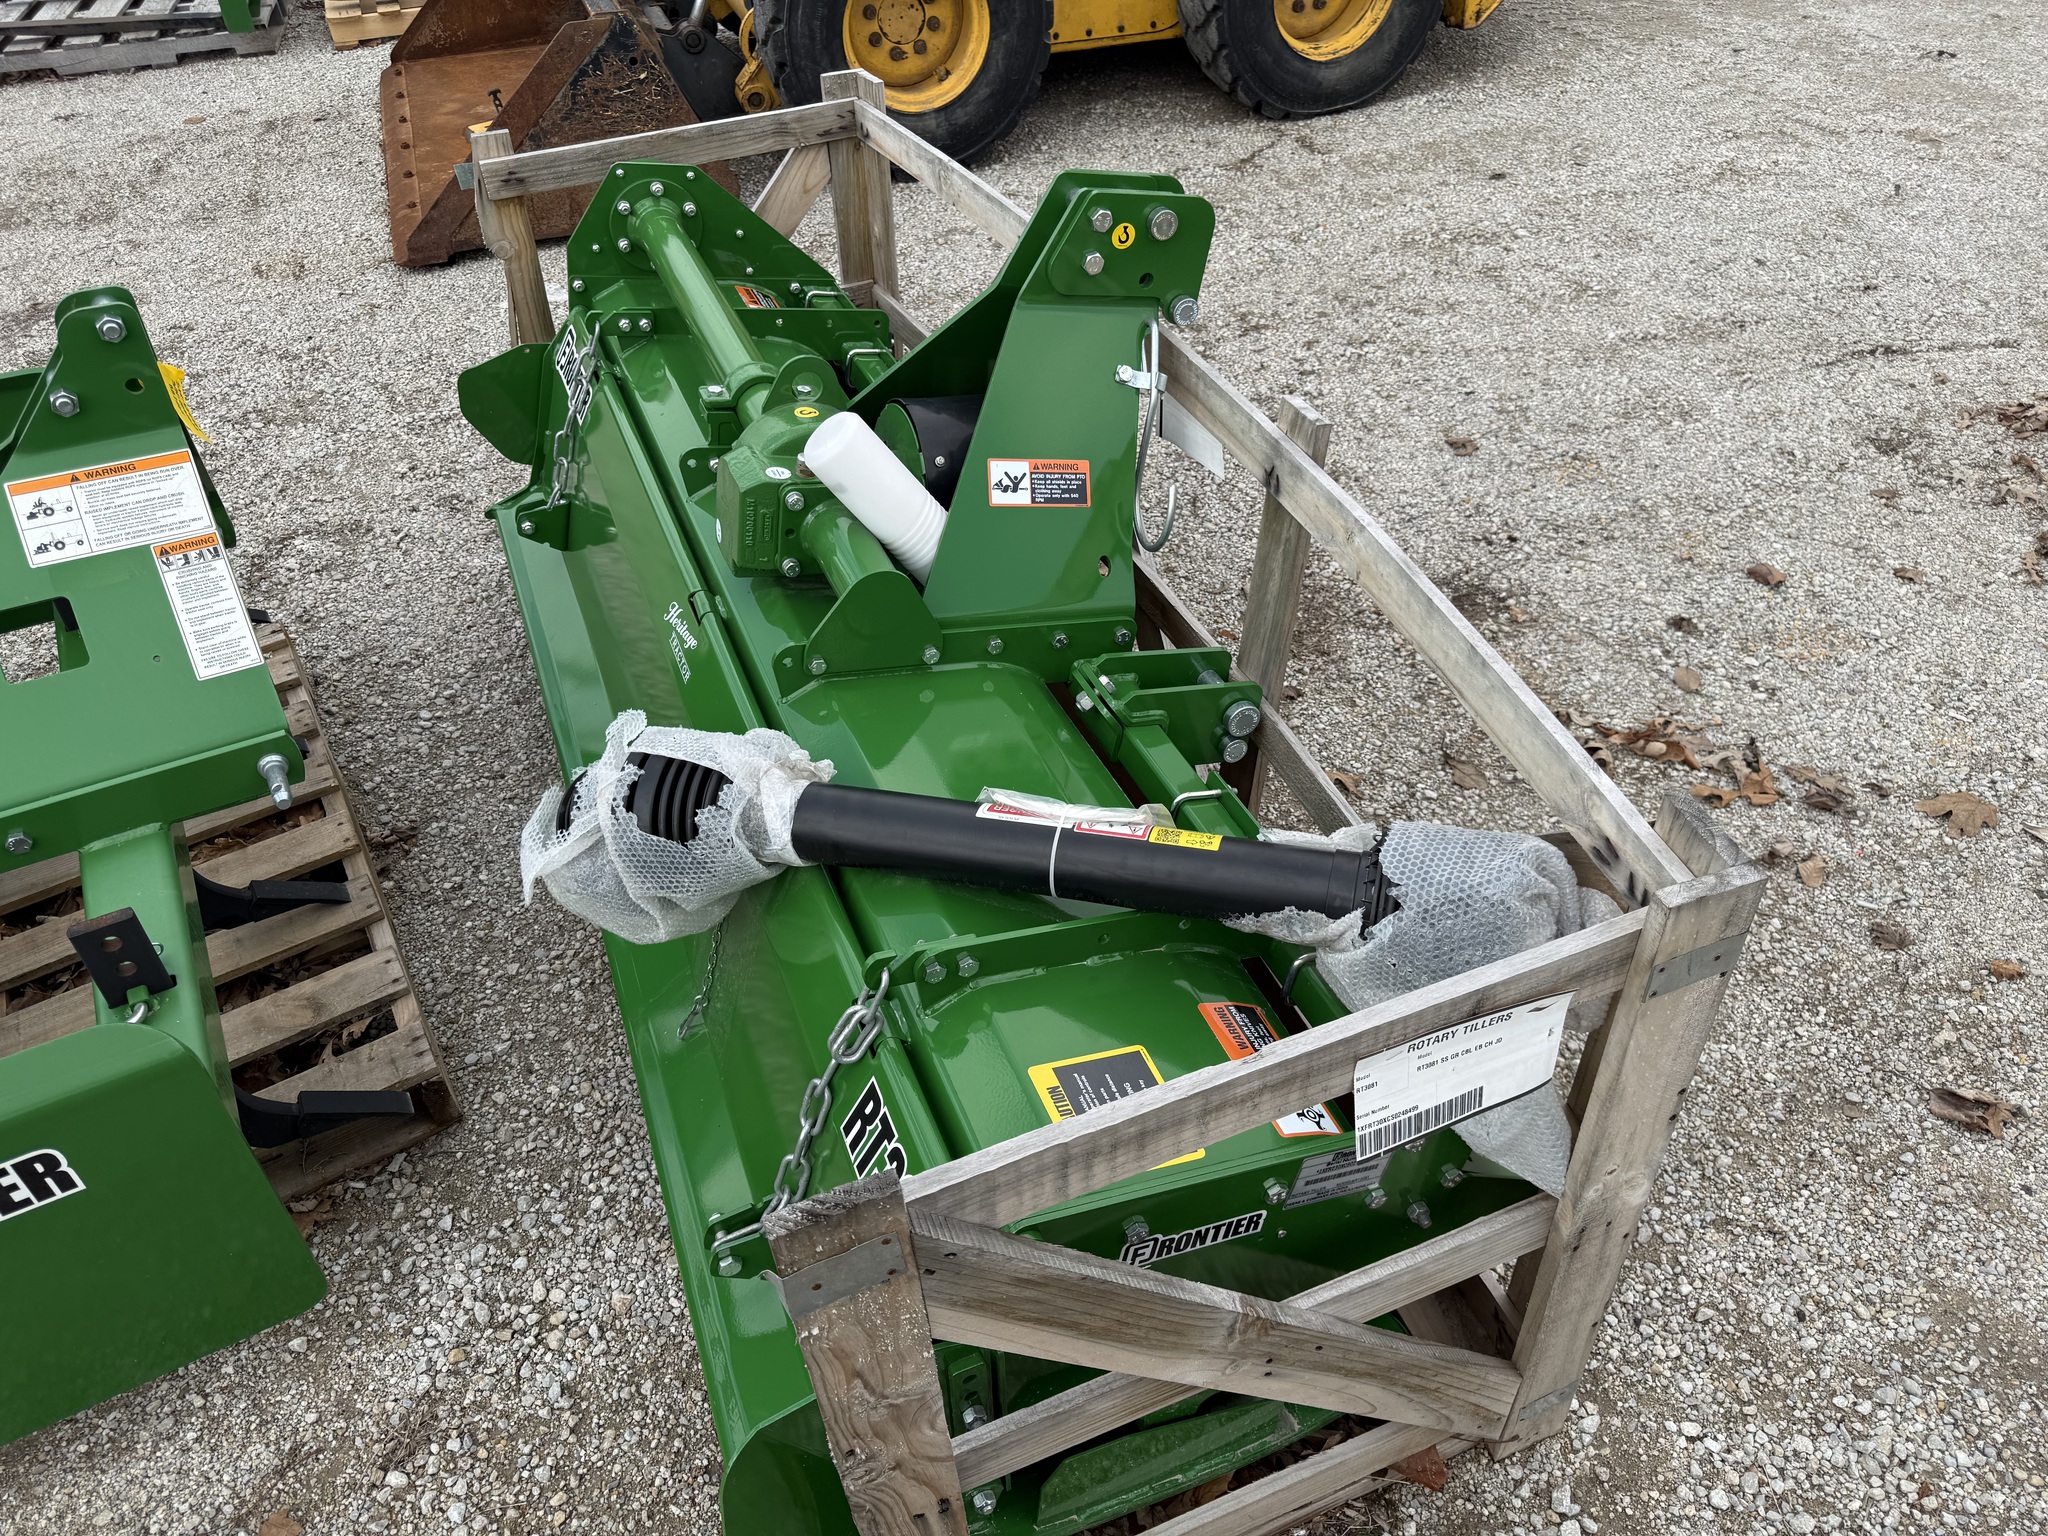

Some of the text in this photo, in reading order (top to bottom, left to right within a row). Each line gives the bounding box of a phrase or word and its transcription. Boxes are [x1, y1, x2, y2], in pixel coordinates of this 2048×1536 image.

[84, 463, 136, 478] WARNING
[103, 502, 130, 510] IMPLEMENT
[147, 522, 177, 531] UNDERNEATH
[178, 516, 203, 525] IMPLEMENT
[169, 536, 214, 552] WARNING
[663, 601, 698, 650] Heritage
[670, 632, 690, 683] TRACTOR
[1228, 1006, 1245, 1025] FROM
[1213, 1007, 1249, 1050] WARNING
[1240, 1013, 1260, 1037] KNIVES
[1407, 1011, 1514, 1054] ROTARY TILLERS
[1241, 1026, 1262, 1050] INJURY
[1416, 1059, 1439, 1072] RT3081
[1450, 1052, 1460, 1060] GR
[1484, 1040, 1494, 1048] CH
[1417, 1051, 1433, 1060] Model
[1073, 1073, 1085, 1090] manual
[1104, 1073, 1118, 1093] distance
[1356, 1072, 1371, 1082] Model
[1356, 1081, 1378, 1094] RT3081
[1079, 1095, 1090, 1111] ANUAL
[1356, 1104, 1390, 1120] Serial Number
[1121, 1212, 1264, 1266] FRONTIER
